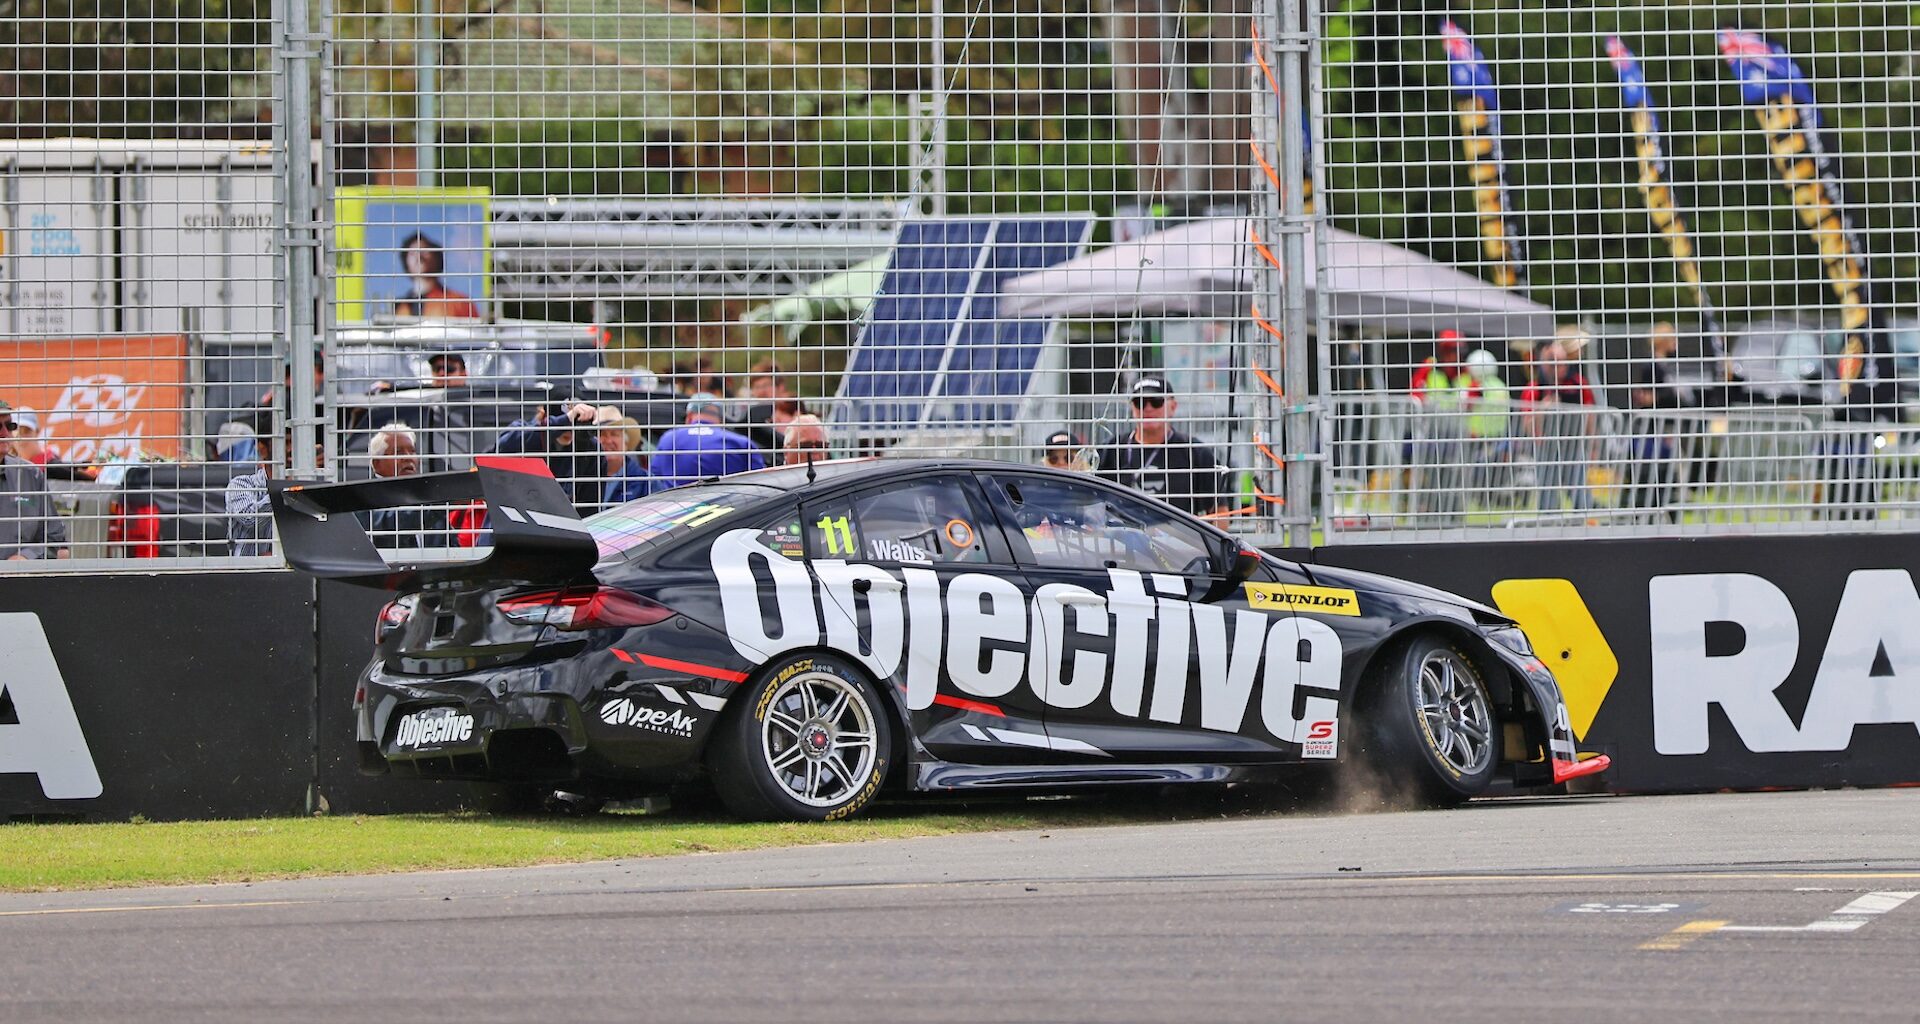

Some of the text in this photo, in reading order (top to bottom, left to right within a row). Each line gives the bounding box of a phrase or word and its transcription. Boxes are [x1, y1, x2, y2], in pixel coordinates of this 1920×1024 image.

[816, 516, 855, 555] 11
[1271, 592, 1350, 608] DUNLOP
[711, 527, 1344, 744] Objective
[396, 710, 475, 749] Objective
[636, 722, 692, 738] MARKETING
